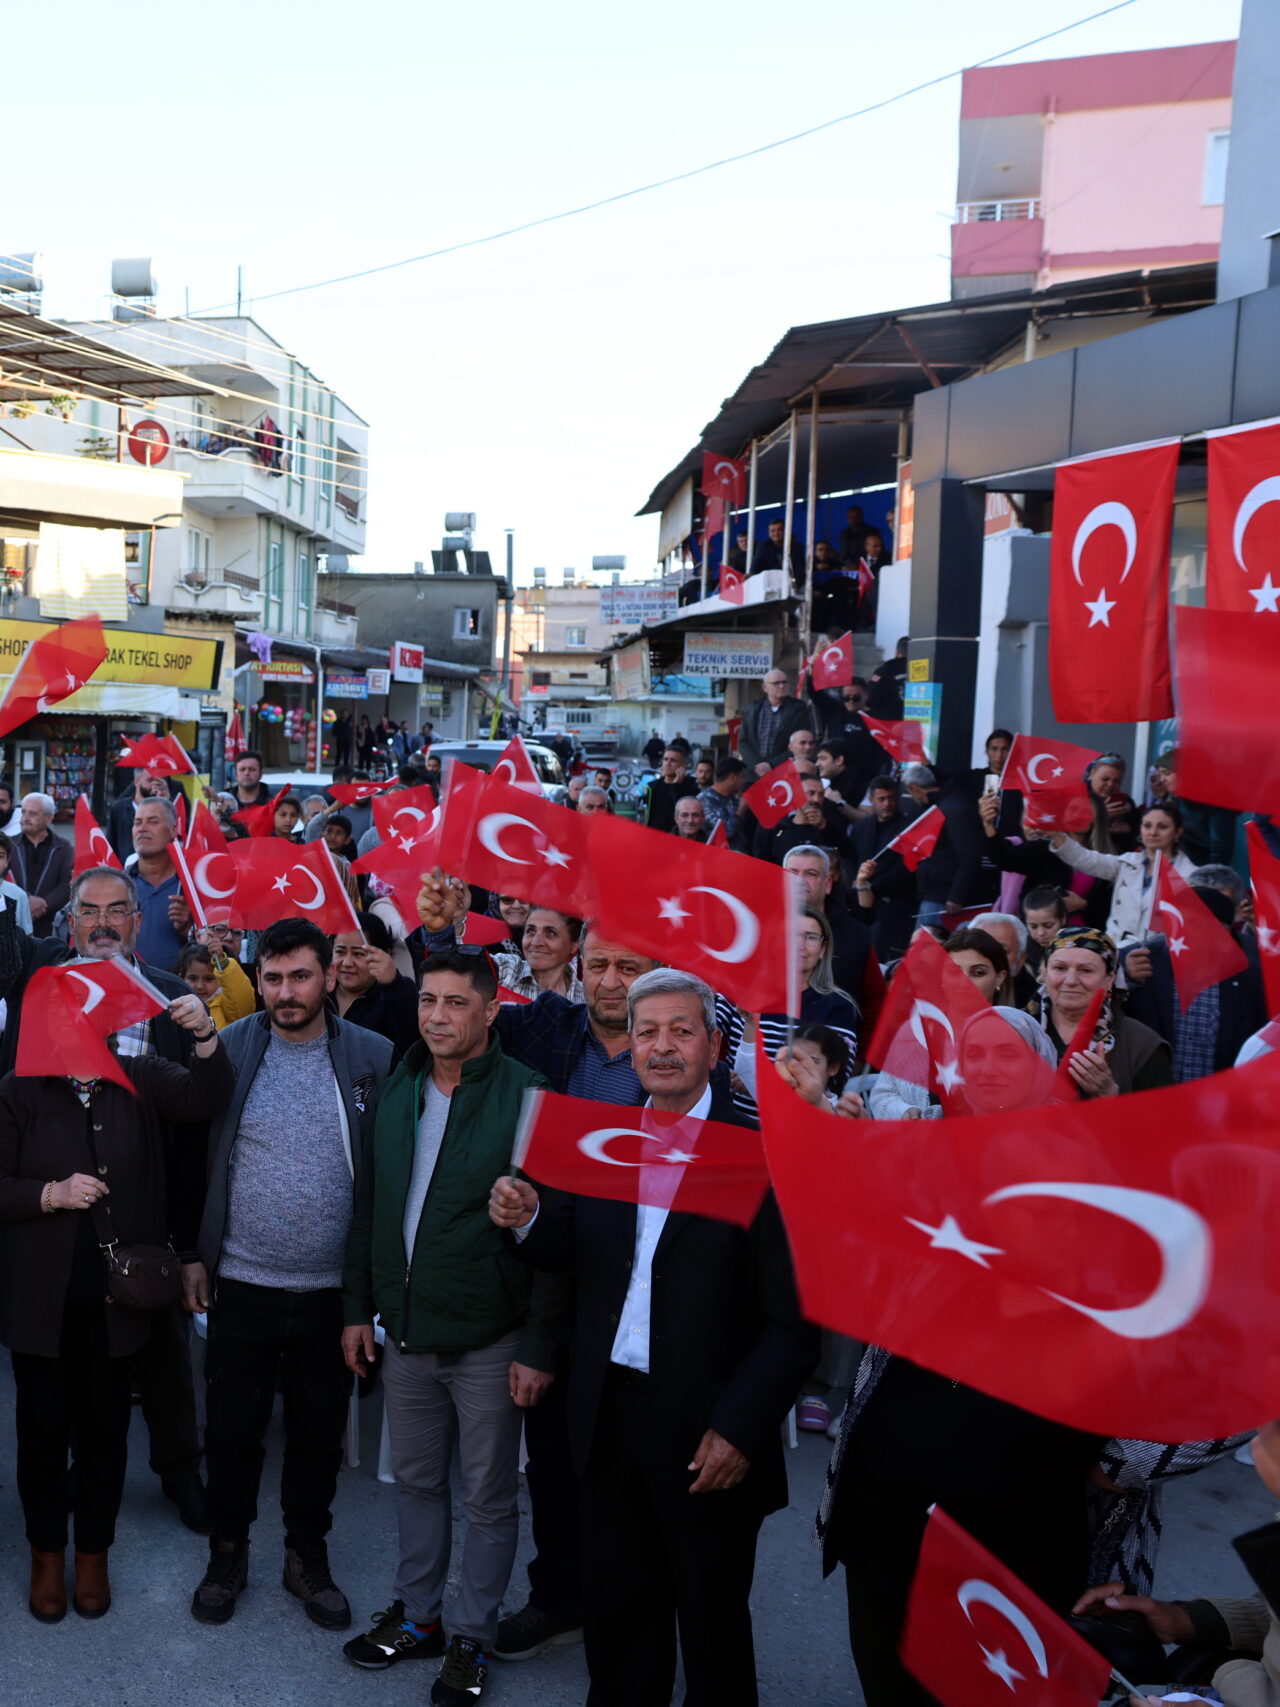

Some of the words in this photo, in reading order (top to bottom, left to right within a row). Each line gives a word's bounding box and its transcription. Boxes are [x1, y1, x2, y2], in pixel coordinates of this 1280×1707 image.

[104, 648, 125, 664] RAK
[128, 649, 161, 668] TEKEL
[163, 653, 192, 670] SHOP
[685, 665, 710, 675] PARÇA
